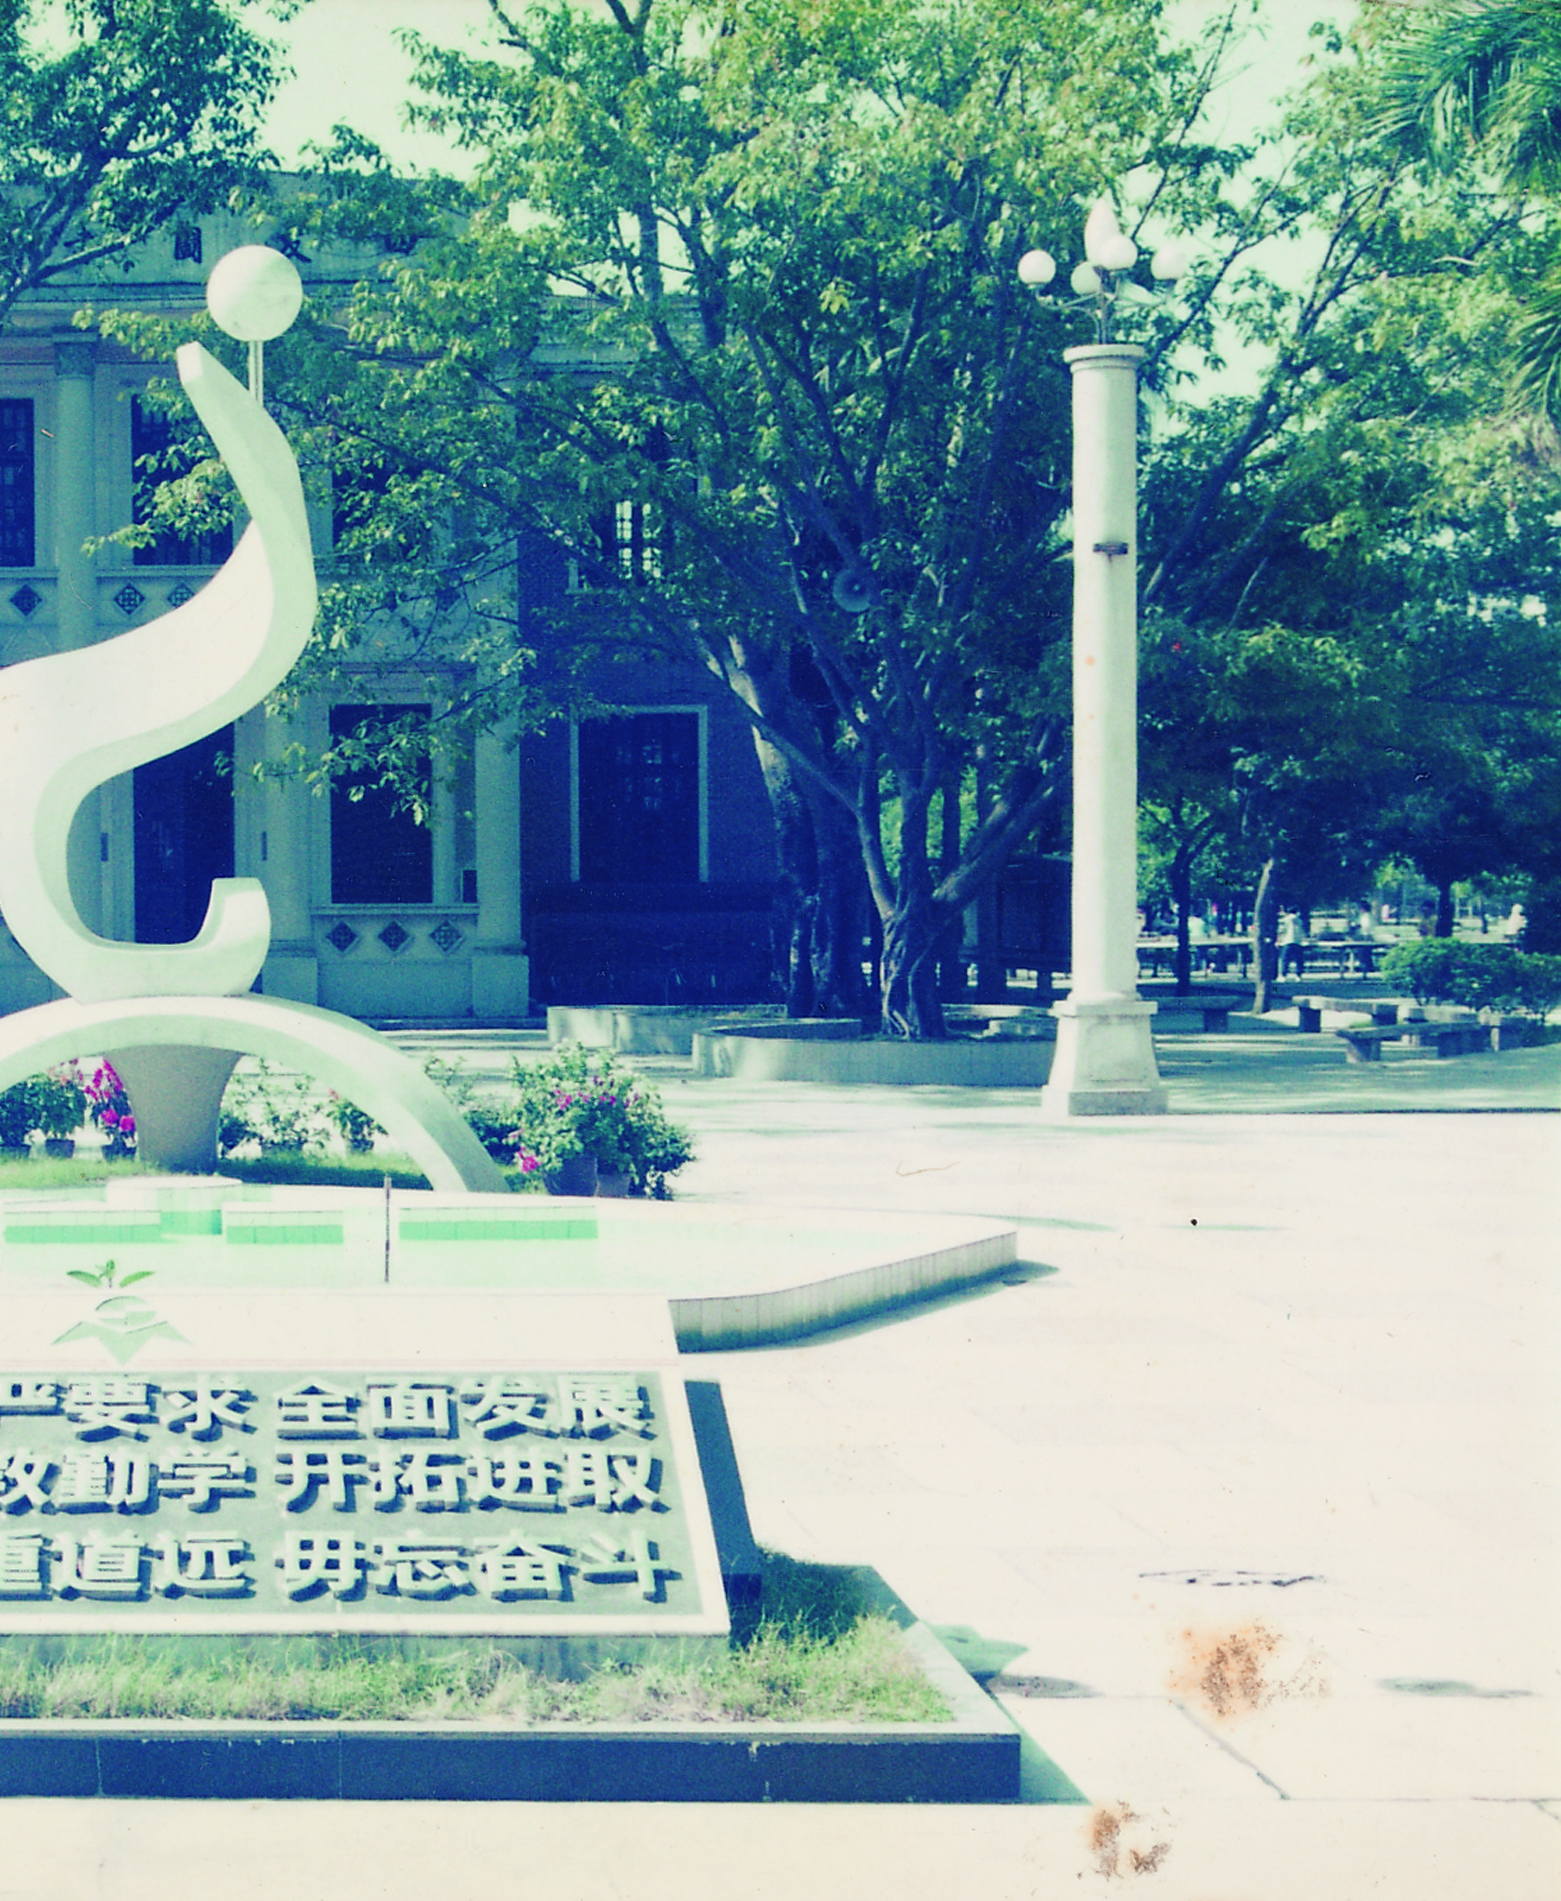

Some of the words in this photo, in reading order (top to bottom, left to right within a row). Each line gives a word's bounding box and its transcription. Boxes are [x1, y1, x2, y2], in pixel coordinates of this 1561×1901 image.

[274, 1373, 655, 1440] 全面发展
[274, 1444, 670, 1513] 开拓进取
[275, 1528, 680, 1602] 毋忘奋斗
